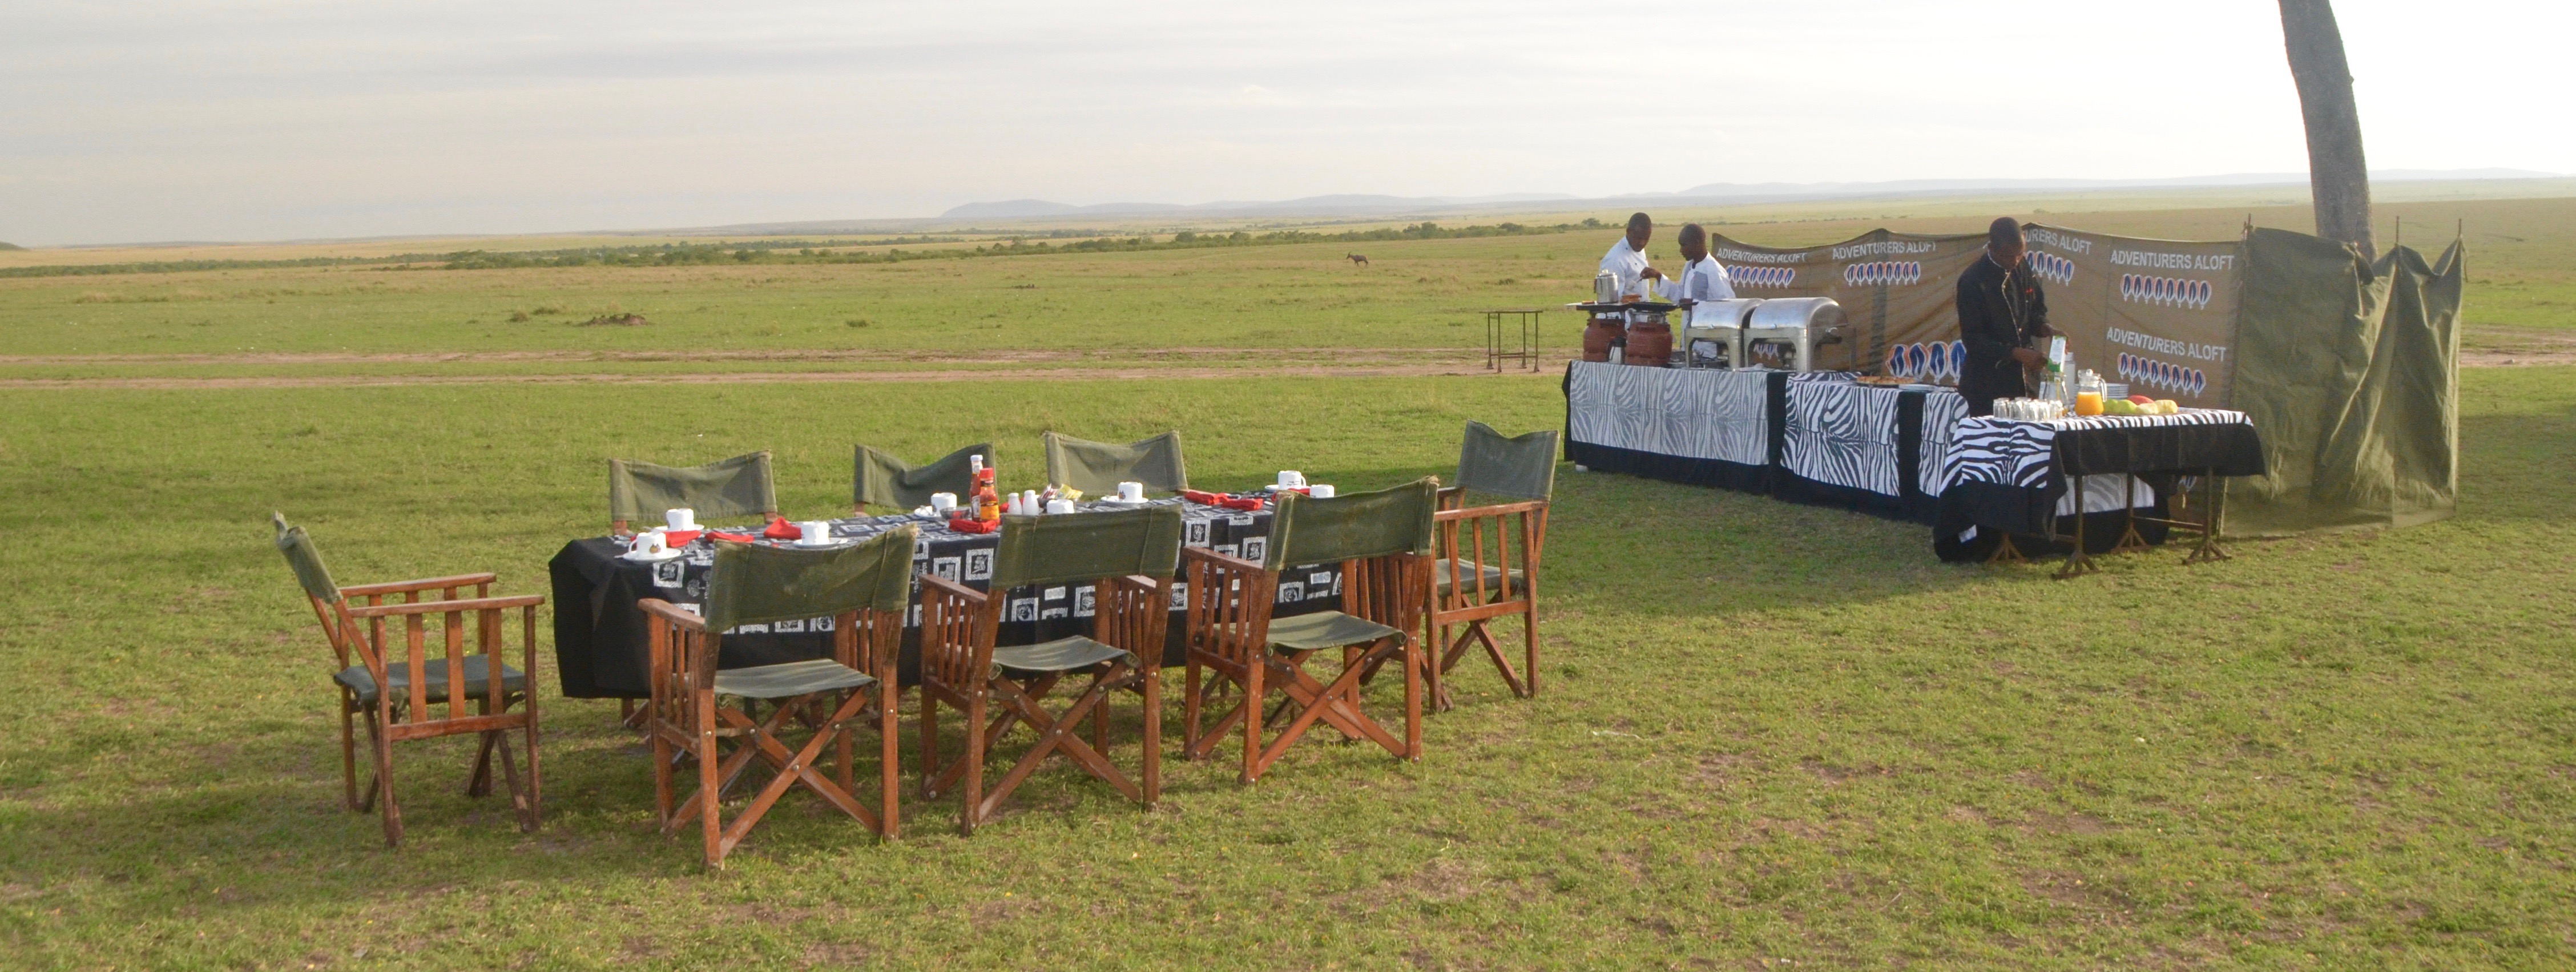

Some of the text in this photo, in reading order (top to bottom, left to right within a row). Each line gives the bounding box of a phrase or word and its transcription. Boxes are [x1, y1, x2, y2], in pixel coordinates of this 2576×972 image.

[1832, 241, 1905, 259] ADVENTURERS
[2025, 229, 2091, 255] URERS ALOFT
[1716, 248, 1775, 263] ADVENTURERS
[2110, 250, 2234, 270] ADVENTURERS ALOFT
[2107, 327, 2225, 362] ADVENTURERS ALOFT
